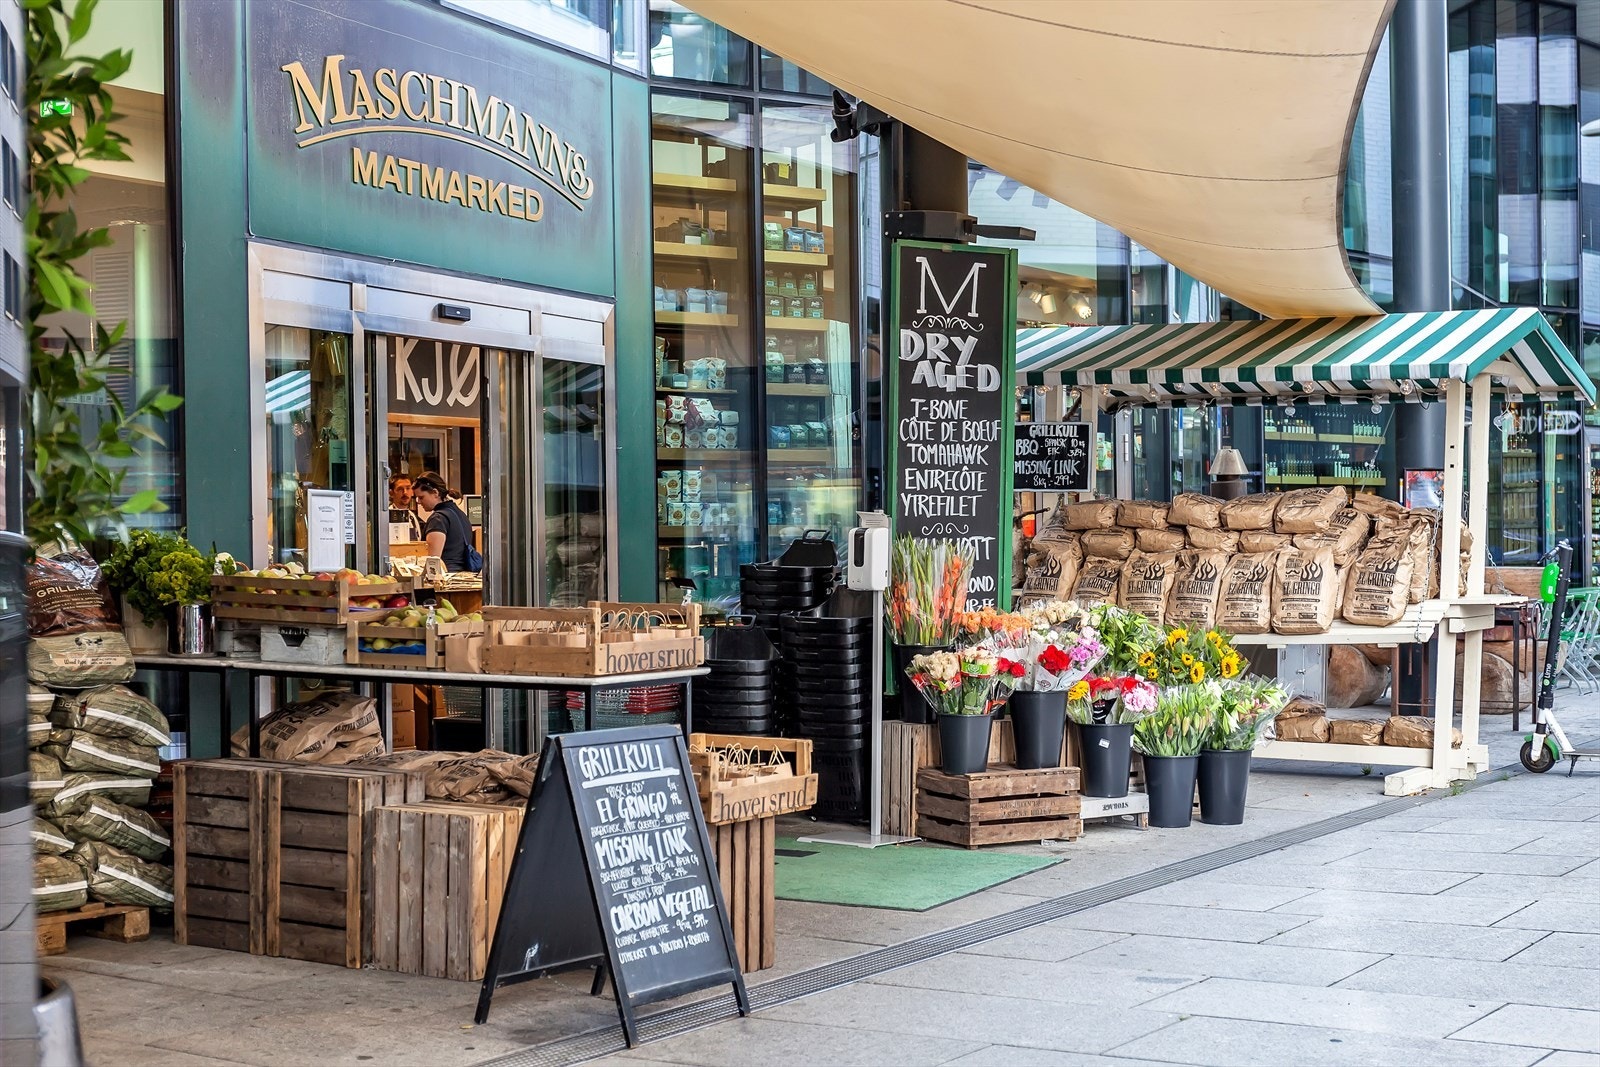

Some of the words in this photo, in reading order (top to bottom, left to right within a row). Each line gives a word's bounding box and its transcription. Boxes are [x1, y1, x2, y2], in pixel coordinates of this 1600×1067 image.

[281, 54, 594, 200] MASCHMANNS
[352, 147, 545, 222] MATMARKED
[916, 256, 987, 318] M
[899, 328, 979, 366] DRY
[911, 360, 1001, 393] AGED
[910, 398, 969, 420] T-BONE
[900, 416, 934, 442] CÔTE
[941, 421, 958, 442] DE
[962, 419, 1001, 442] BOEUF
[1029, 425, 1079, 438] GRILLKULL
[906, 443, 989, 466] TOMAHAWK
[1015, 439, 1039, 456] BBQ
[904, 465, 988, 493] ENTRECÔTE
[1014, 460, 1052, 477] MISSING
[1054, 459, 1080, 476] LINK
[901, 492, 983, 518] YTREFILET
[578, 743, 665, 779] GRILLKULL
[596, 797, 619, 824] EL
[618, 791, 668, 825] GRINGO
[1102, 802, 1129, 811] STORAGE
[594, 834, 653, 869] MISSING
[654, 826, 693, 862] LINK
[610, 898, 662, 935] CARBON
[659, 885, 715, 920] VEGETAL
